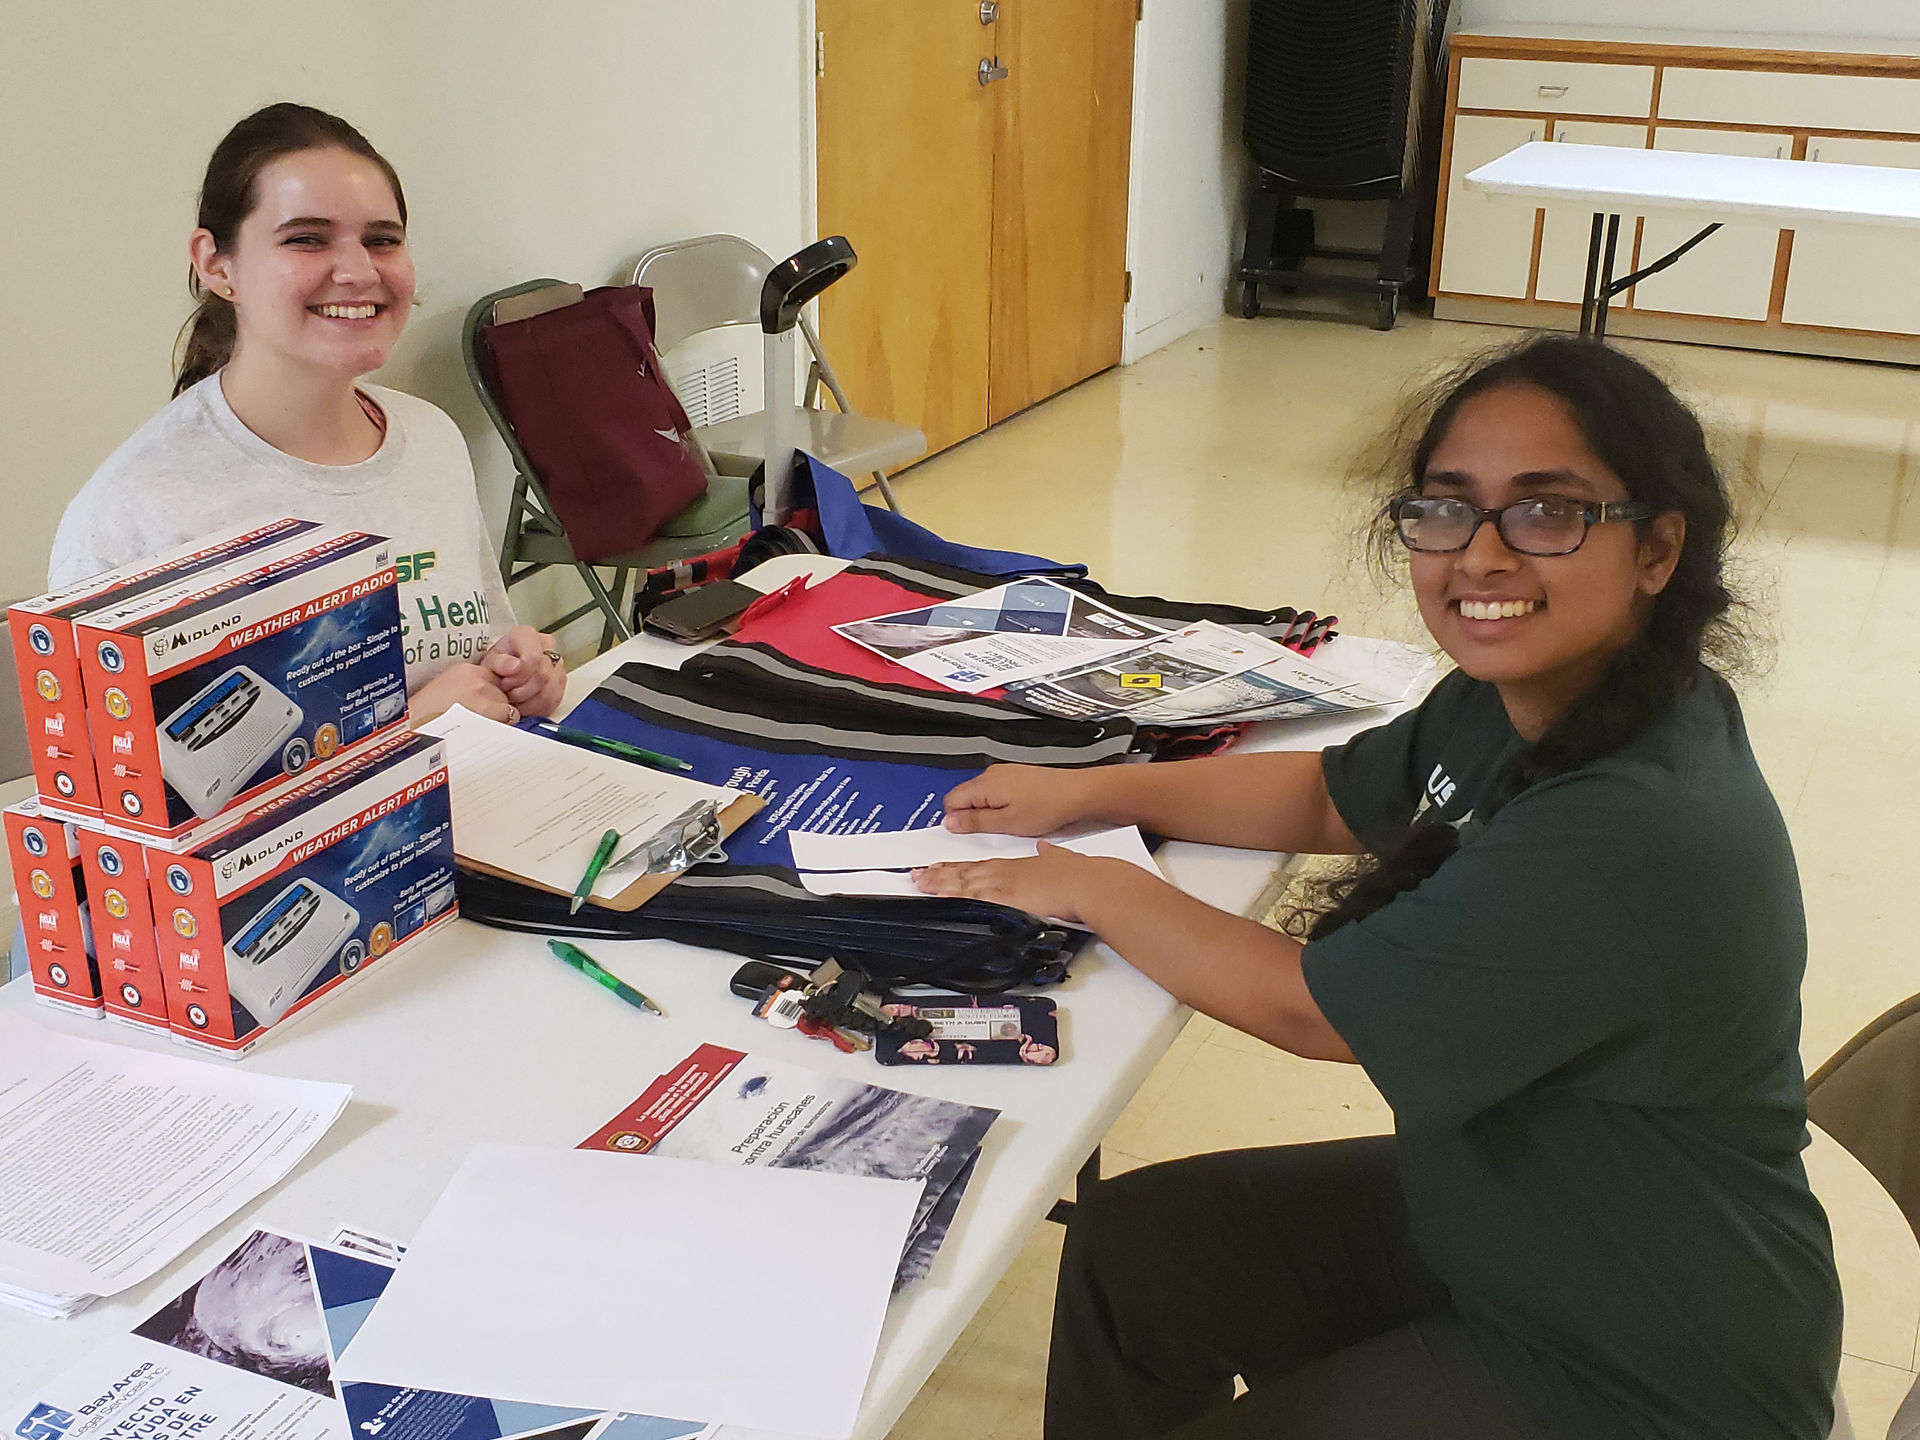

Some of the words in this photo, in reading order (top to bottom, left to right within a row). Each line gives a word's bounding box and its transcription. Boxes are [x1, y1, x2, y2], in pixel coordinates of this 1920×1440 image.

[120, 556, 196, 585] WEATHER
[200, 538, 245, 556] ALERT
[247, 519, 294, 539] RADIO
[189, 568, 266, 600] WEATHER
[268, 551, 311, 572] ALERT
[315, 533, 360, 552] RADIO
[396, 551, 436, 583] SF
[171, 614, 242, 650] MIDLAND
[228, 609, 300, 648] WEATHER
[305, 589, 348, 617] ALERT
[351, 571, 394, 598] RADIO
[286, 667, 311, 681] Ready
[311, 660, 324, 670] out
[325, 652, 334, 663] of
[334, 648, 346, 660] the
[348, 643, 361, 653] box
[366, 629, 390, 645] Simple
[391, 625, 398, 634] to
[298, 667, 335, 688] customize
[336, 662, 344, 671] to
[345, 656, 361, 669] your
[362, 641, 390, 659] location
[404, 639, 423, 664] of
[429, 641, 440, 659] a
[447, 633, 472, 659] big
[253, 779, 325, 816] WEATHER
[326, 756, 368, 780] ALERT
[370, 732, 413, 756] RADIO
[292, 818, 358, 863] WEATHER
[361, 795, 403, 826] ALERT
[406, 770, 446, 801] RADIO
[238, 829, 304, 872] MIDLAND
[344, 869, 366, 887] Ready
[368, 861, 380, 872] out
[381, 853, 388, 865] of
[389, 849, 400, 860] the
[402, 841, 415, 853] box
[419, 825, 442, 843] Simple
[442, 822, 449, 830] to
[355, 868, 390, 892] customize
[391, 863, 398, 872] to
[399, 853, 415, 868] your
[415, 838, 442, 858] location
[731, 1100, 790, 1154] Preparación
[741, 1134, 772, 1166] ontra
[767, 1093, 817, 1143] huracanes
[69, 1413, 103, 1438] Legal
[100, 1381, 148, 1415] Services
[145, 1366, 167, 1381] Inc.
[78, 1391, 115, 1416] Bay
[112, 1362, 153, 1392] Area
[174, 1385, 203, 1405] EN
[167, 1411, 195, 1430] DE
[176, 1413, 218, 1440] TRE
